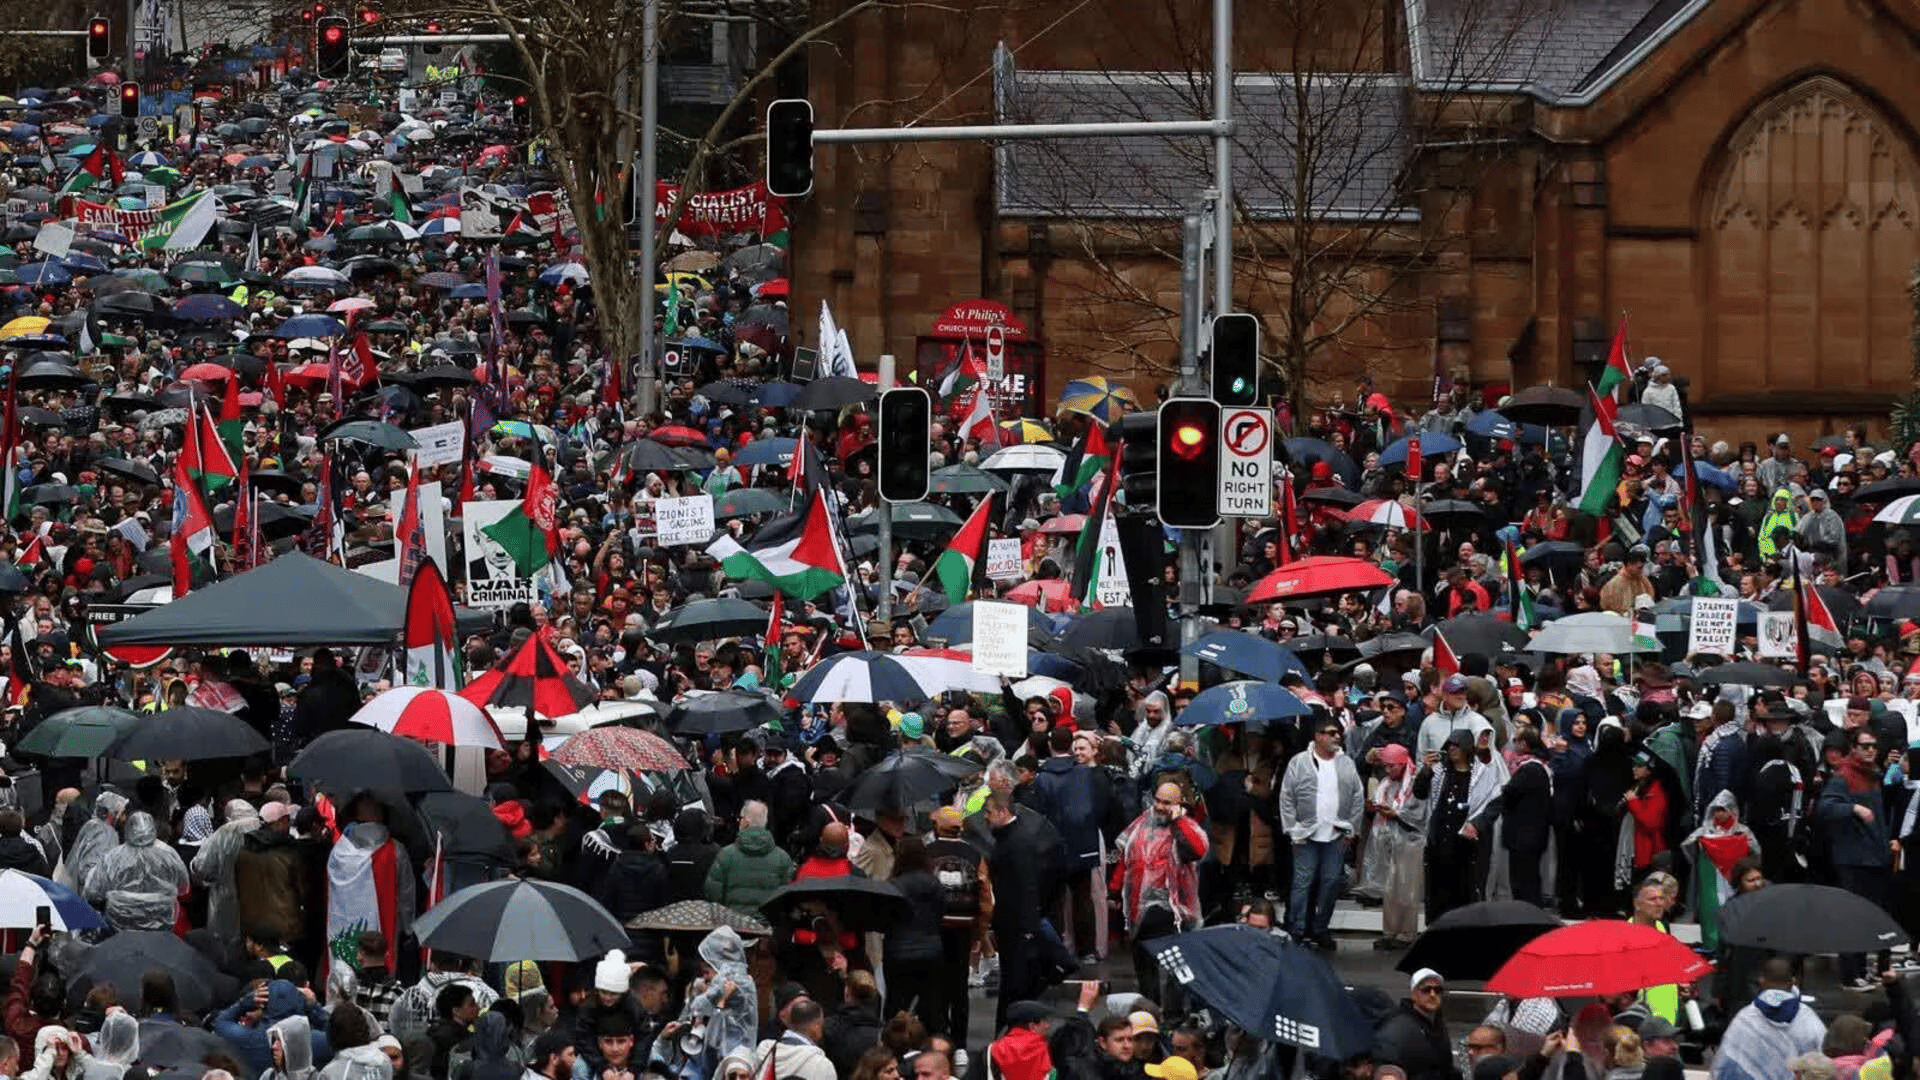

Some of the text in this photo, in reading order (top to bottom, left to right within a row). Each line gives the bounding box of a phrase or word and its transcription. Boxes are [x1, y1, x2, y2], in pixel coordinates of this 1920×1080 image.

[667, 189, 757, 208] SCIALIST
[954, 308, 965, 319] St
[1231, 461, 1259, 478] NO
[1224, 481, 1265, 493] RIGHT
[1226, 497, 1263, 509] TURN
[659, 507, 704, 520] ZIONIST
[470, 578, 533, 591] WAR
[471, 589, 533, 602] CRIMINAL
[89, 612, 116, 620] FREE
